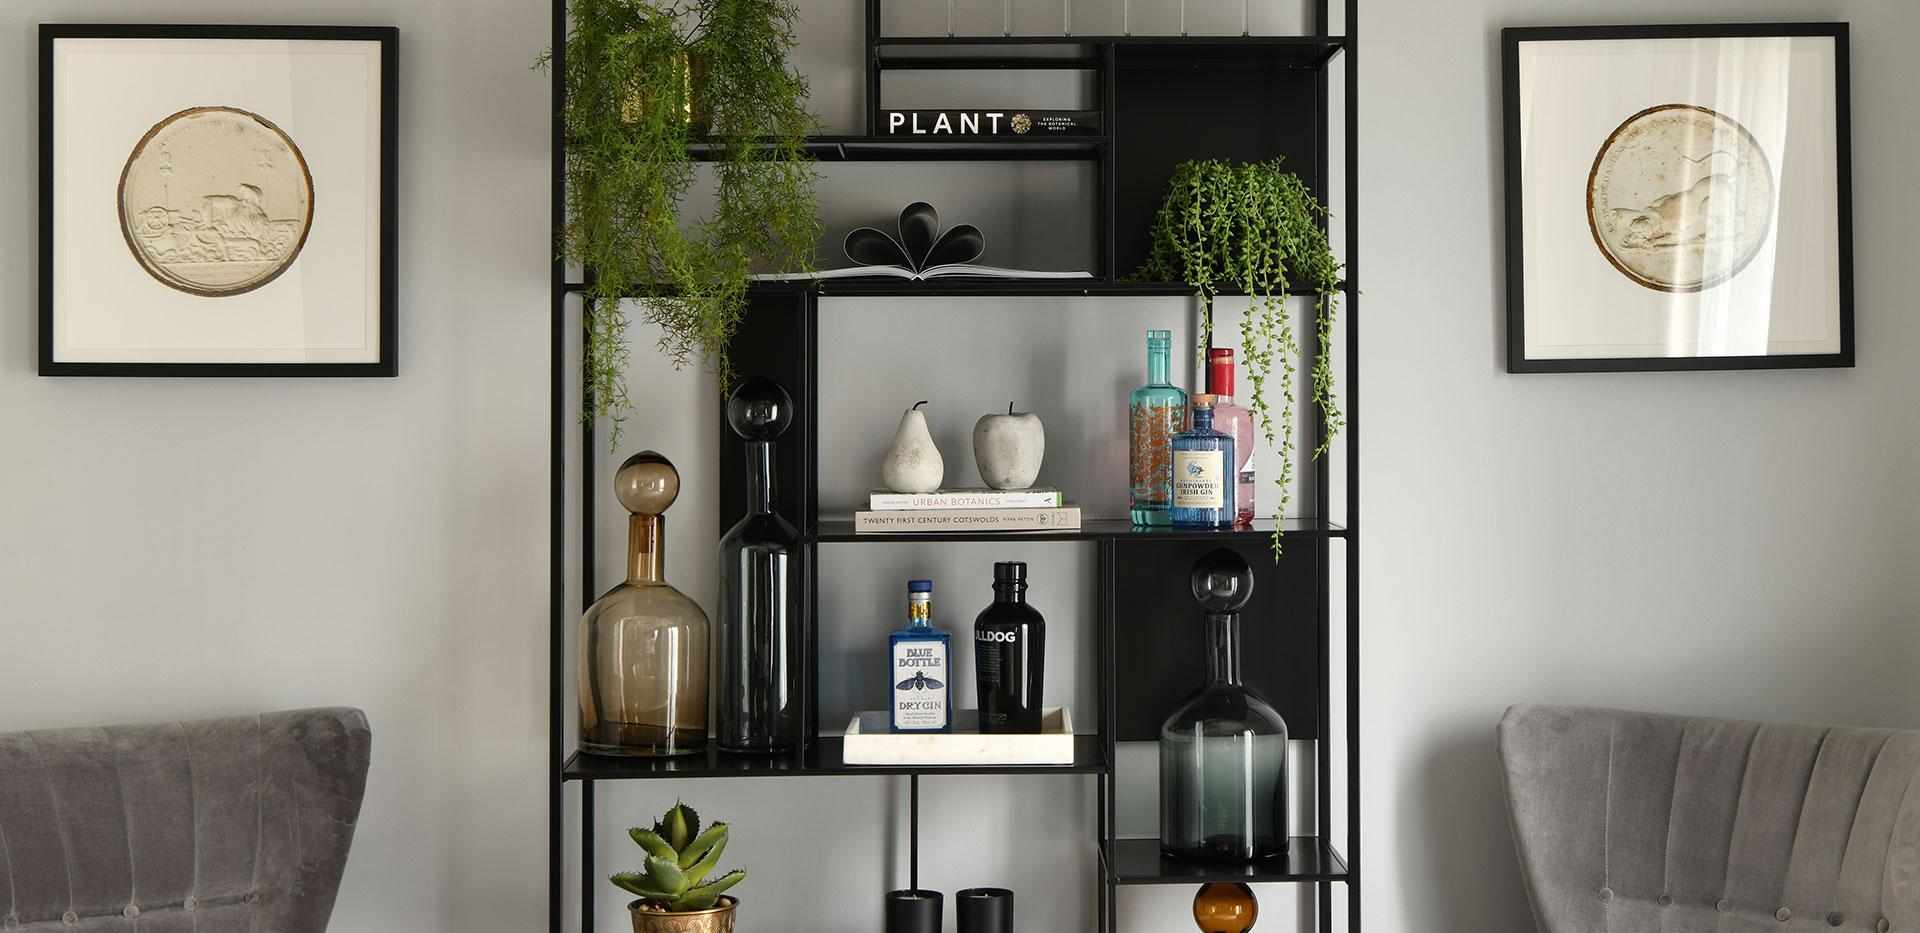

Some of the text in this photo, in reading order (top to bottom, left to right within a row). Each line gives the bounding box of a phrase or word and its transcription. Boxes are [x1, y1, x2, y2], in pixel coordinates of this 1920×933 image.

[889, 112, 1004, 134] PLANT
[912, 497, 946, 506] URBAN
[951, 497, 1001, 506] BOTANICS
[953, 516, 999, 524] COTSWOLDS
[906, 648, 933, 657] BLUE
[898, 657, 941, 667] BOTTLE
[899, 701, 942, 710] DRY GIN
